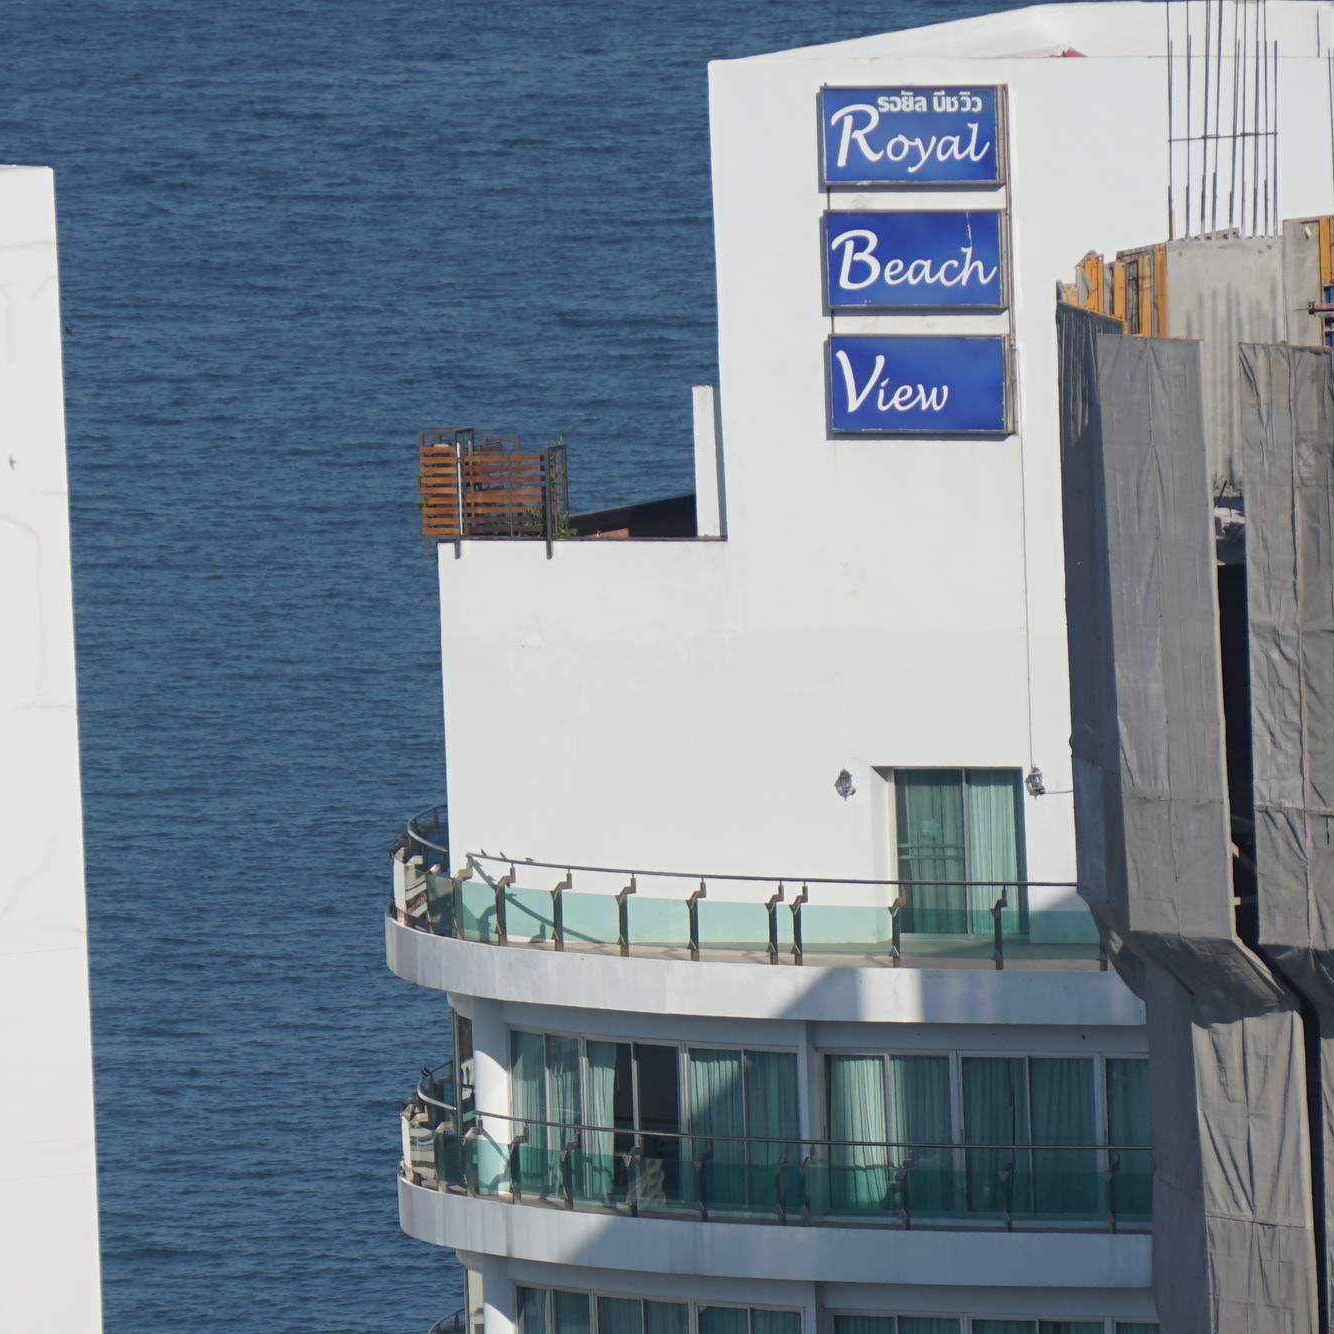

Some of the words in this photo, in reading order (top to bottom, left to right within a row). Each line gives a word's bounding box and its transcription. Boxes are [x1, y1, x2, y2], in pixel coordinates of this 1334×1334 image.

[831, 103, 990, 172] Royal
[831, 229, 997, 290] Beach
[835, 350, 949, 413] View
